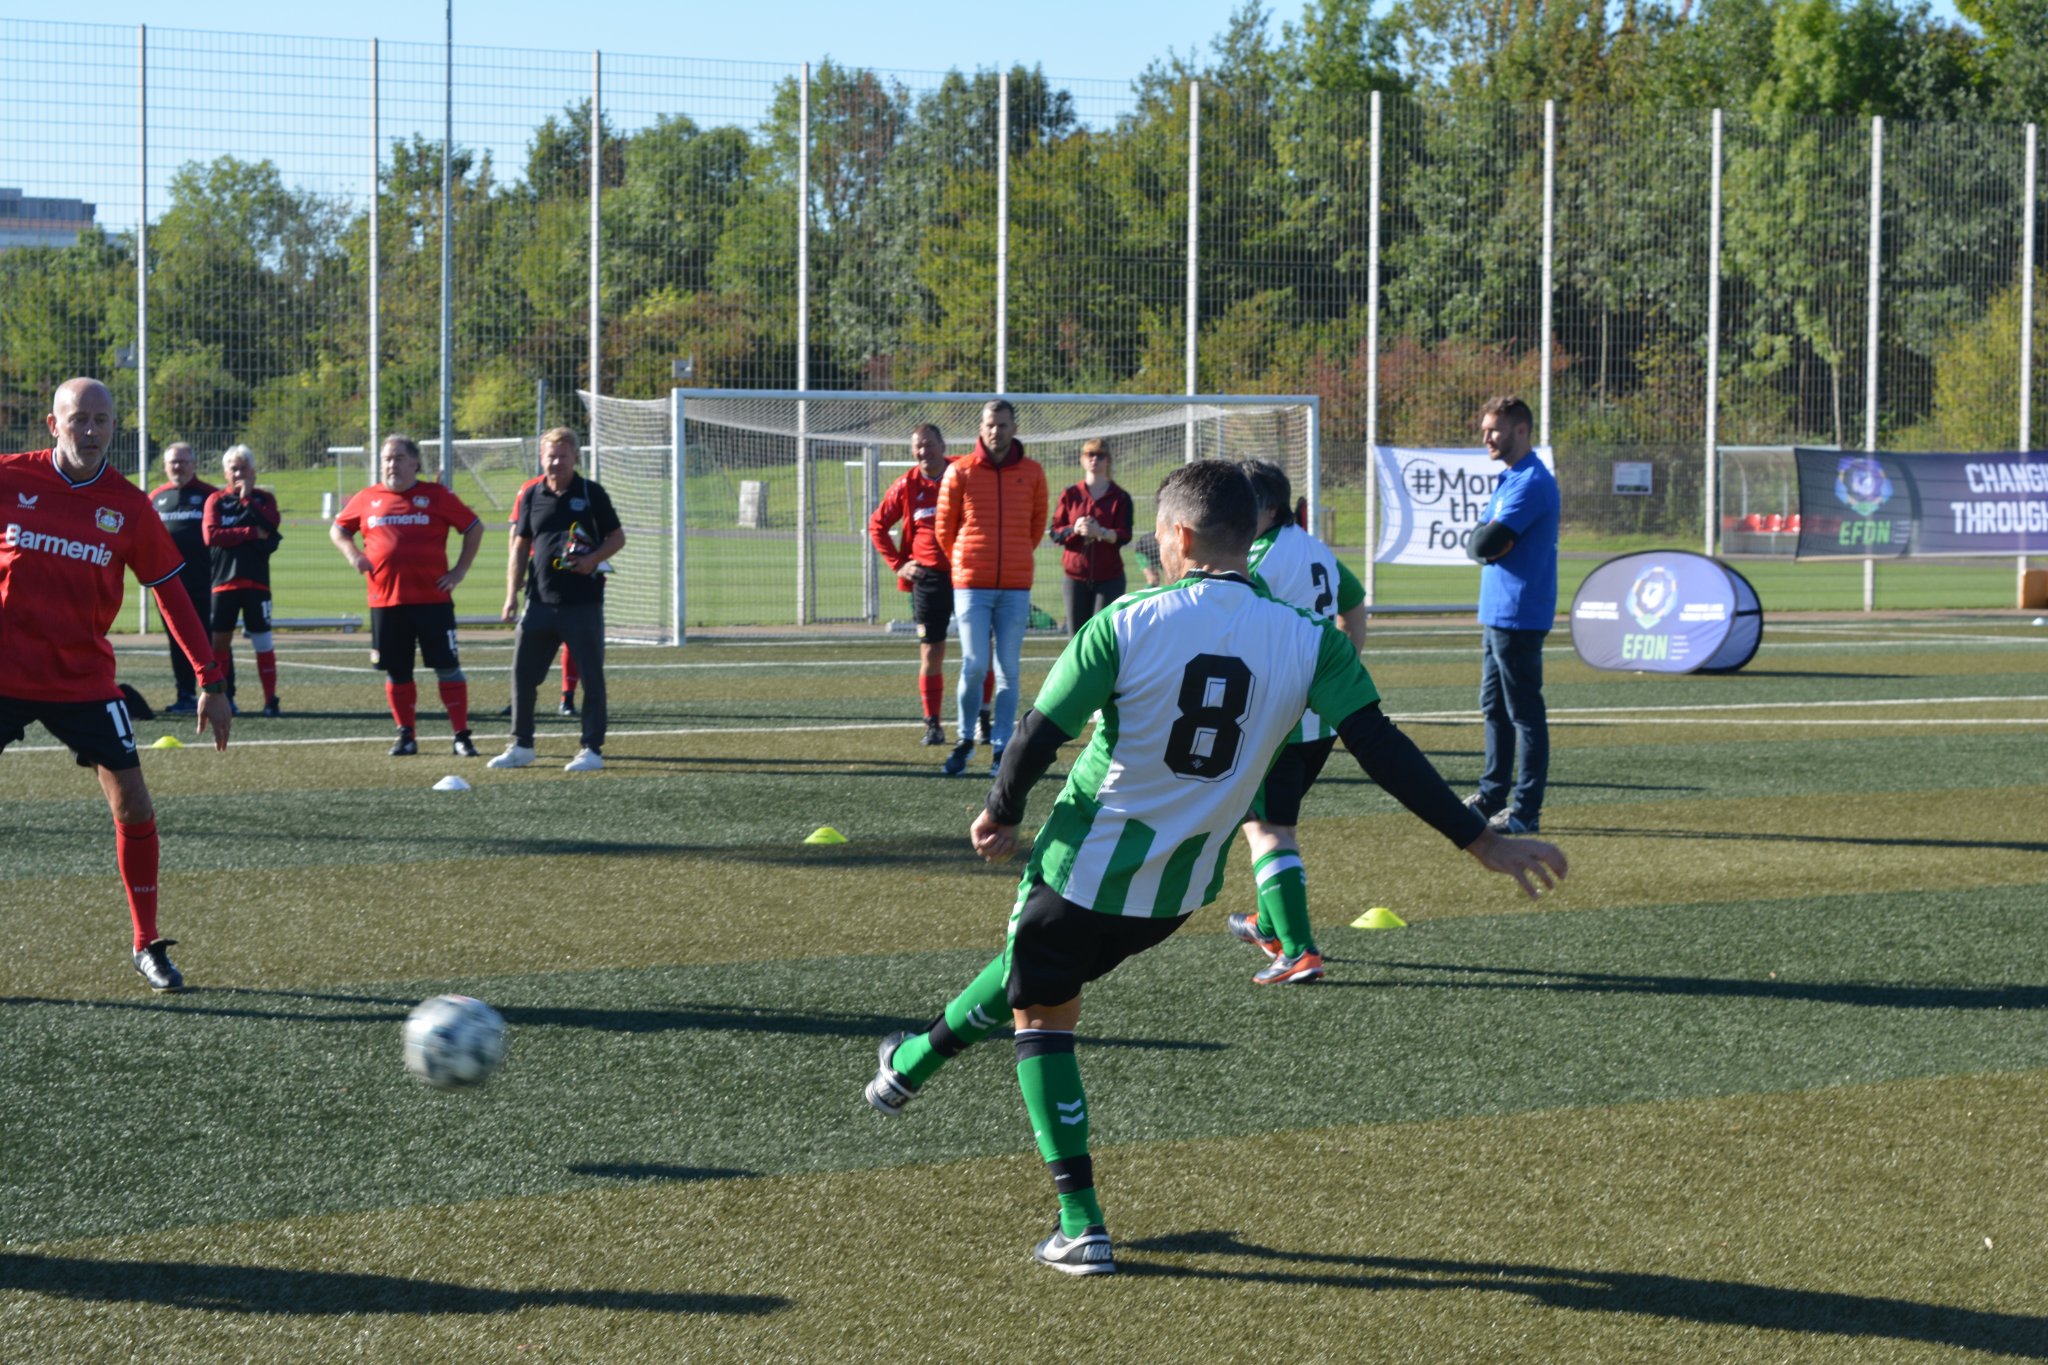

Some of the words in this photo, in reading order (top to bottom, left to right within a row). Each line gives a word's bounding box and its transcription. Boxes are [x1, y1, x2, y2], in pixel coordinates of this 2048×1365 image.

[1403, 458, 1499, 505] #Mor
[1965, 463, 2048, 493] CHANGI
[5, 522, 113, 568] Barmenia
[1839, 520, 1891, 545] EFDN
[1310, 562, 1334, 621] 2
[1622, 633, 1669, 660] EFDN
[1163, 652, 1256, 783] 8
